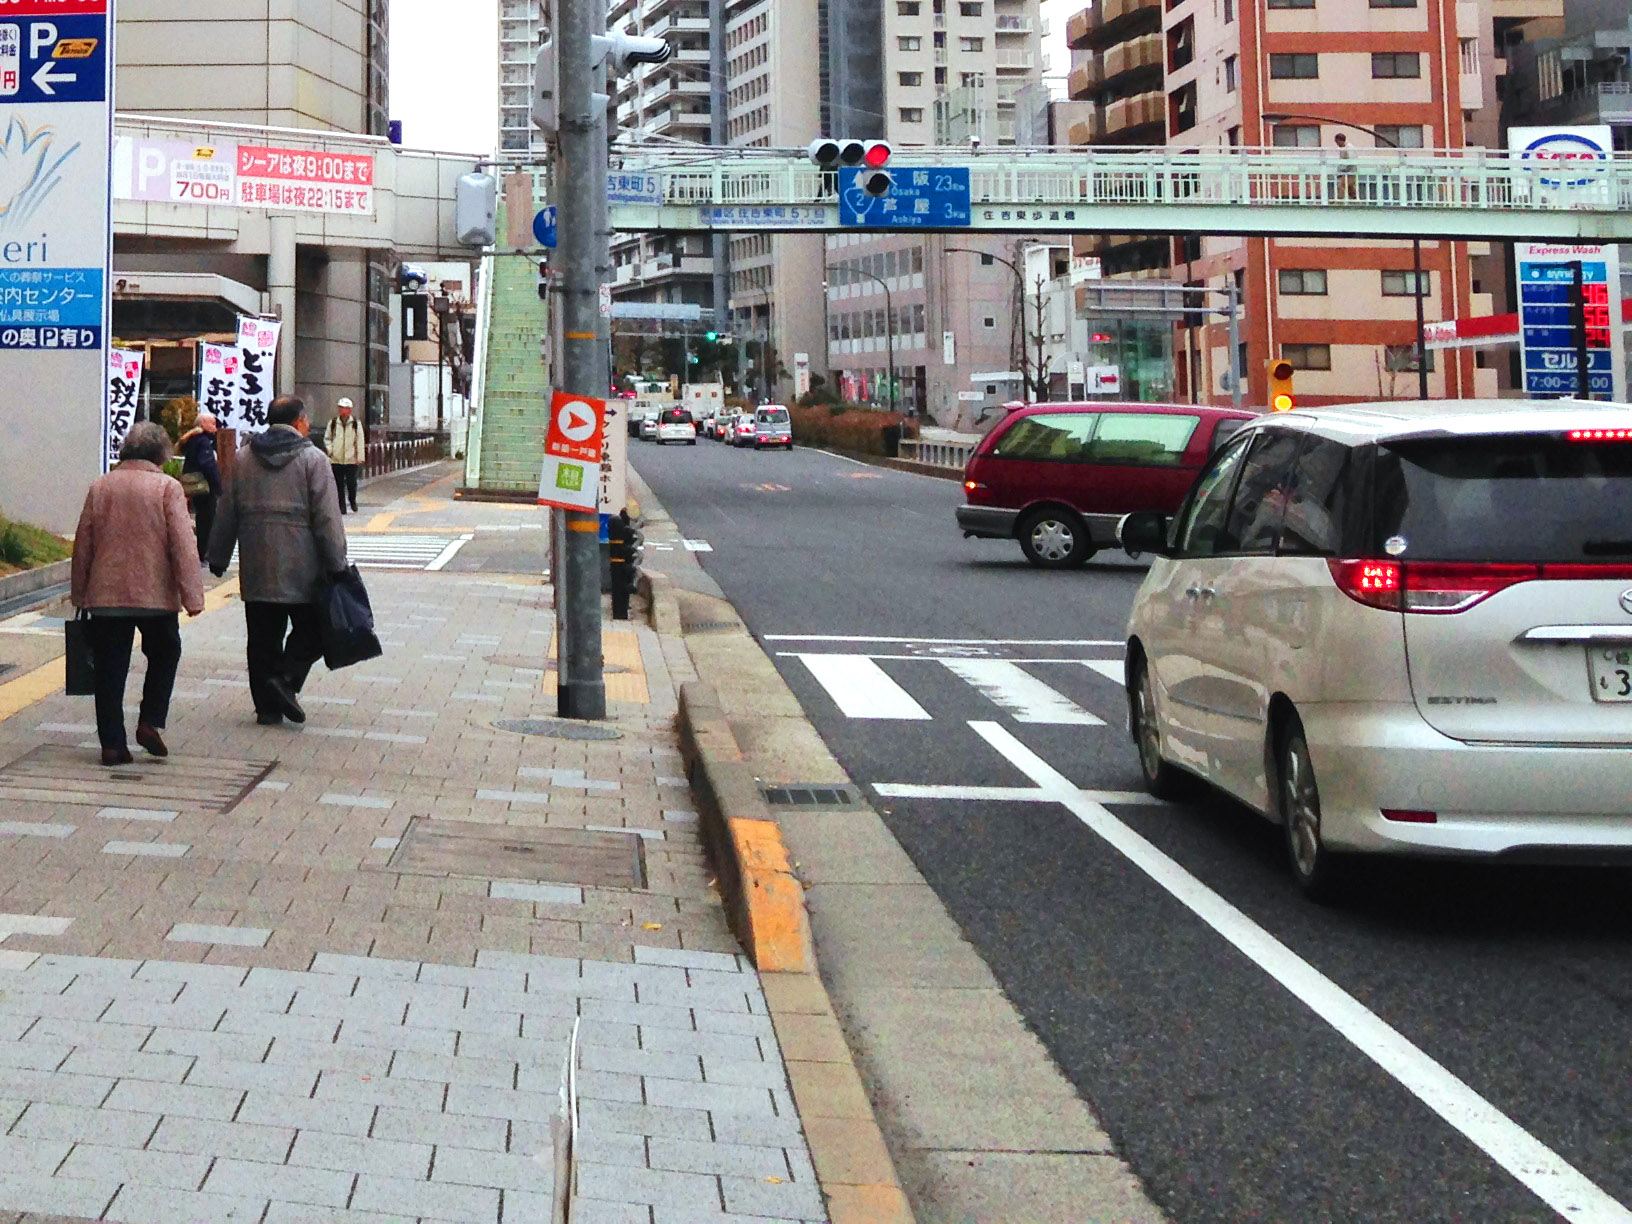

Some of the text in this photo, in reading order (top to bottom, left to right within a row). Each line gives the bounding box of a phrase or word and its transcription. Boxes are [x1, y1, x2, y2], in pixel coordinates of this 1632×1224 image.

[29, 22, 58, 59] P
[241, 151, 368, 182] シーアは夜9:00まで
[176, 181, 230, 200] 700円
[241, 181, 368, 210] 駐車場は夜22:15まで
[855, 194, 865, 206] 2
[882, 198, 930, 214] 芦屋
[892, 215, 922, 225] Ashiya
[1528, 245, 1601, 255] Express Wash
